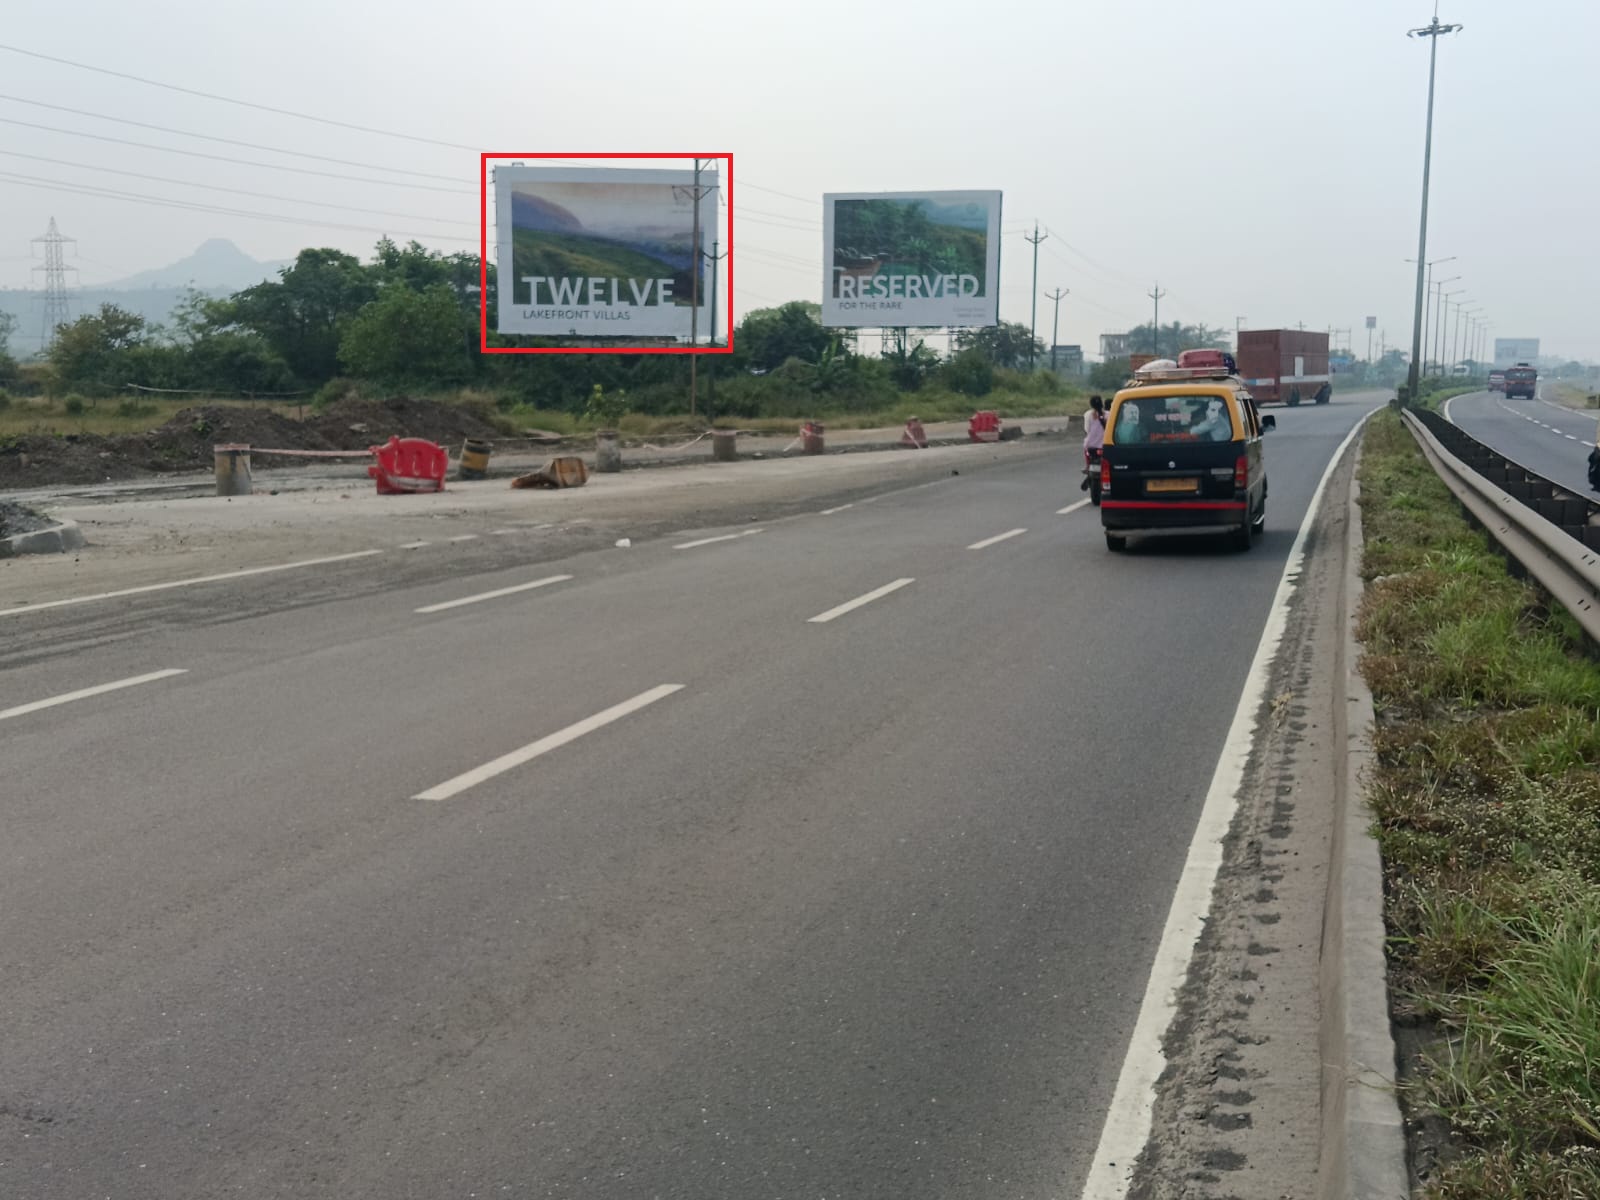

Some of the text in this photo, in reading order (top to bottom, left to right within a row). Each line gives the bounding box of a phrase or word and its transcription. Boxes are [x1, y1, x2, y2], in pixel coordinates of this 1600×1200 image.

[522, 276, 676, 306] TWELVE
[839, 274, 980, 298] RESERVED
[839, 302, 903, 310] FOR THE RARE
[522, 310, 631, 321] LAKEFRONT VILLAS
